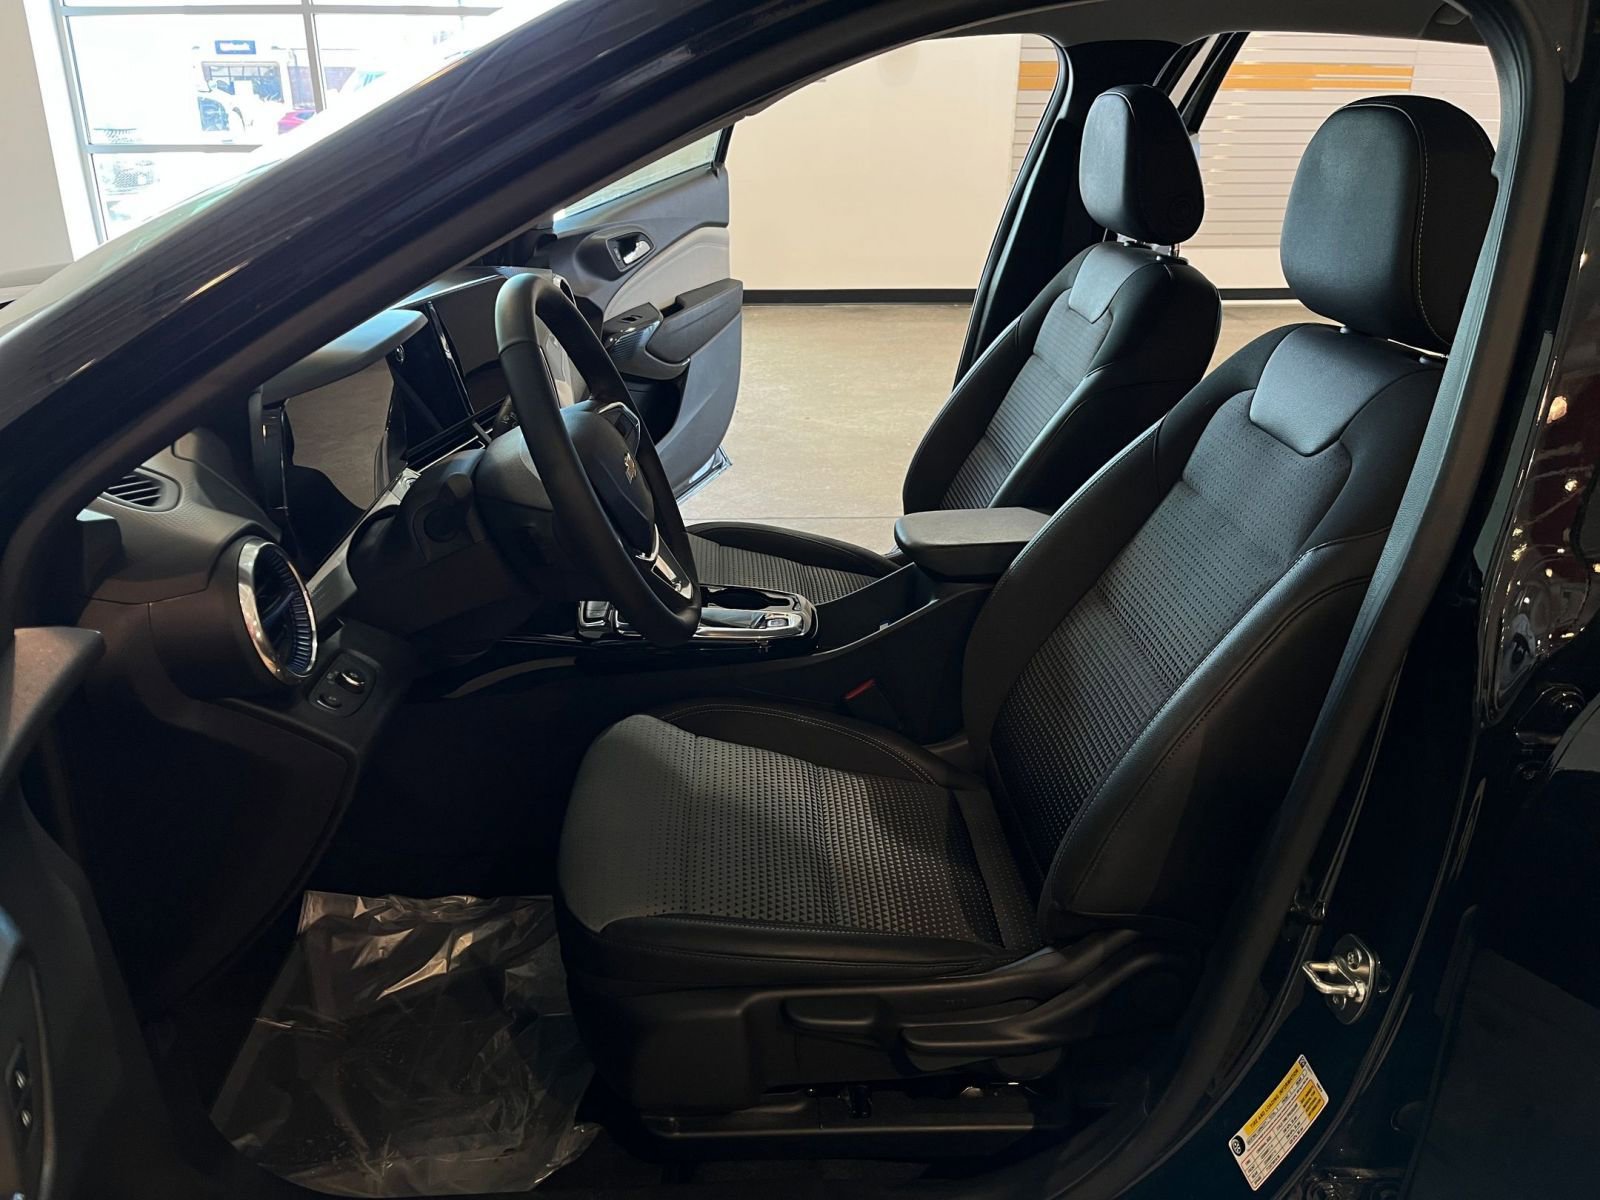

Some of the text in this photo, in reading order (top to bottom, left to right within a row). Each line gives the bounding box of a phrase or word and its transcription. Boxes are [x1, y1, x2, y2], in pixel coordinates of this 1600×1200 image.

[1250, 1118, 1258, 1128] TIRE
[1265, 1094, 1279, 1112] LOADING
[1279, 1068, 1299, 1095] INFORMATION
